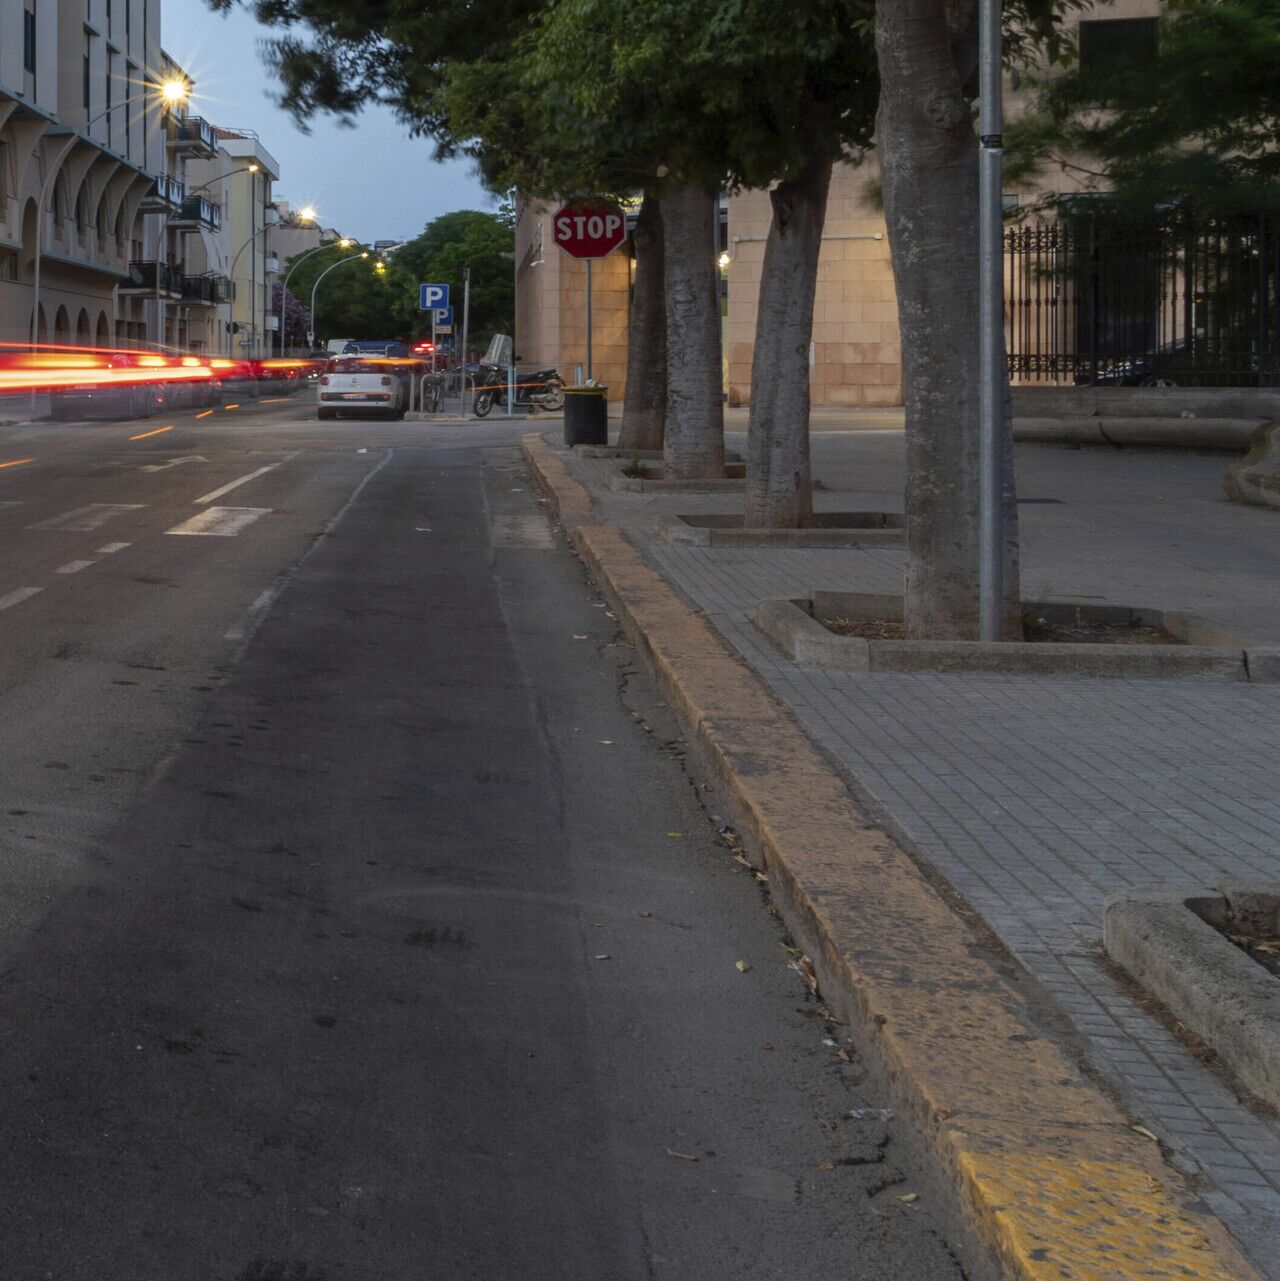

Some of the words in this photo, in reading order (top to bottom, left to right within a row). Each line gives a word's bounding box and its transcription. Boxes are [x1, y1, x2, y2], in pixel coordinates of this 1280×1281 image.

[556, 215, 621, 240] STOP
[426, 286, 443, 307] P
[436, 309, 448, 323] P
